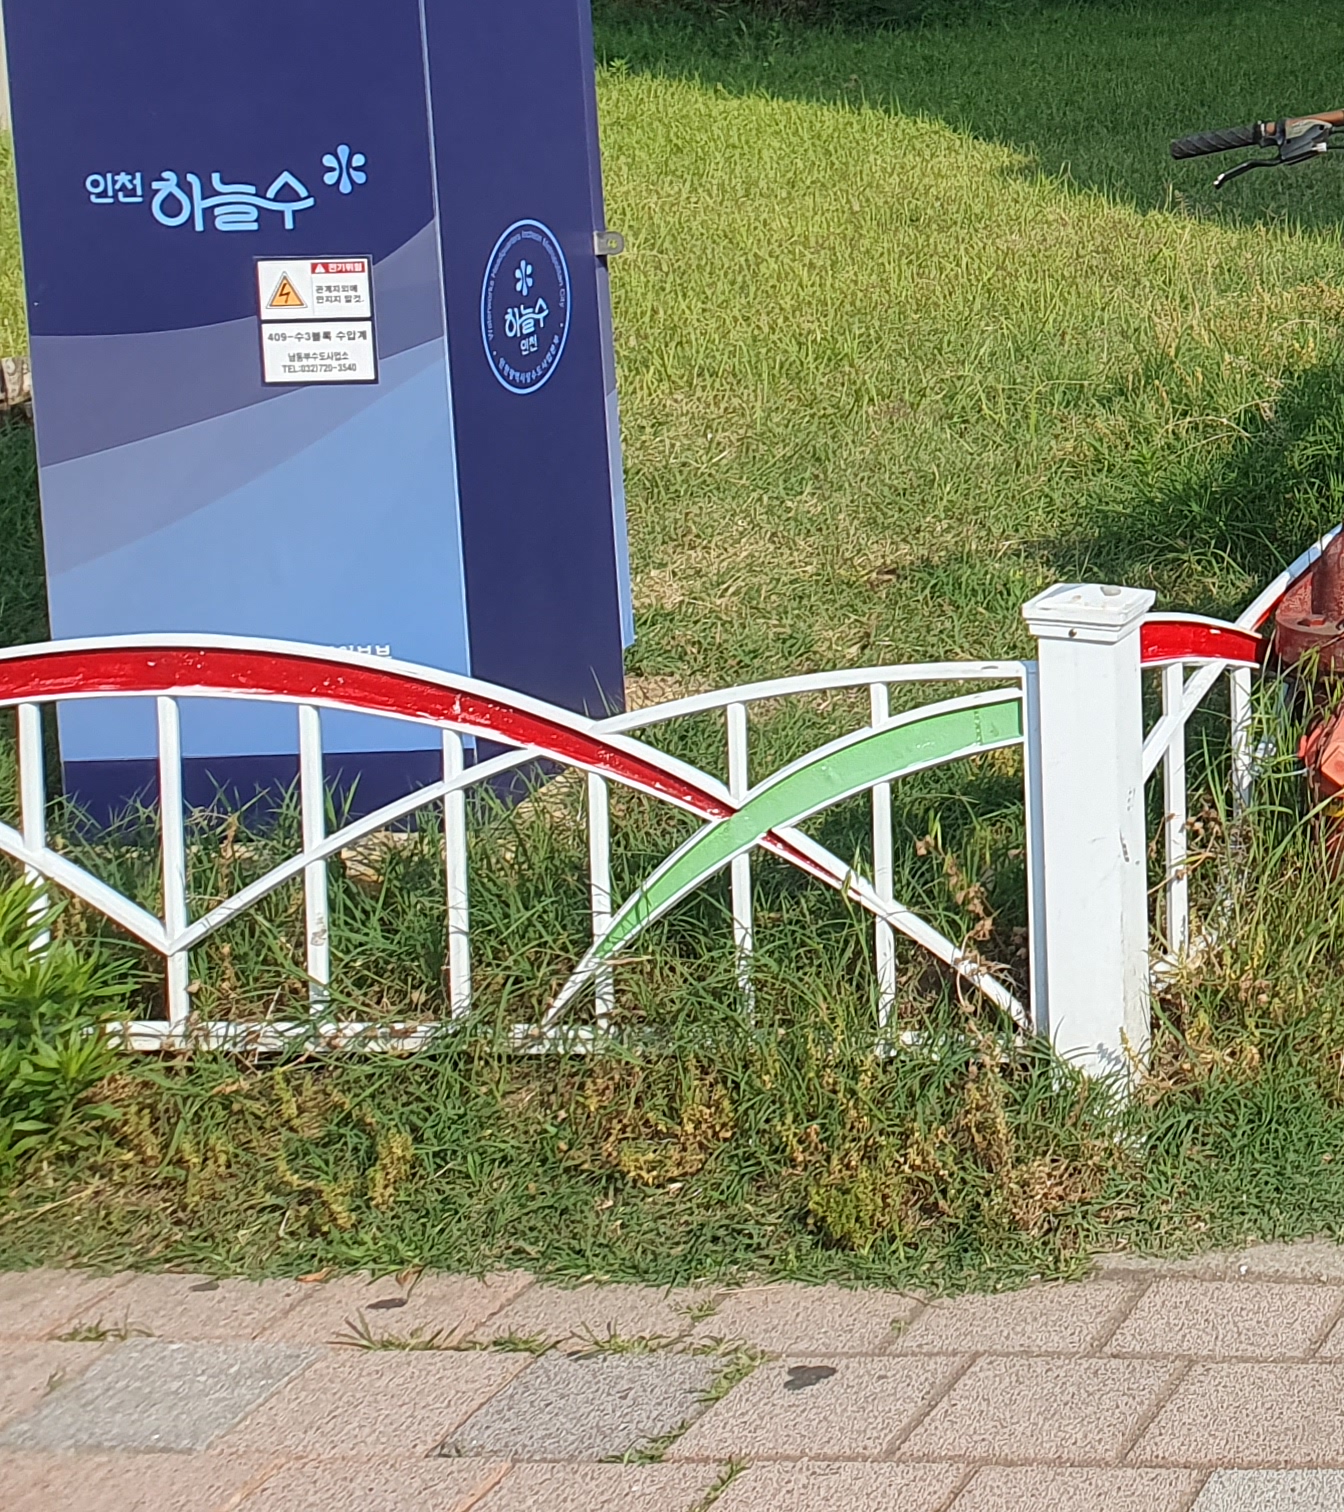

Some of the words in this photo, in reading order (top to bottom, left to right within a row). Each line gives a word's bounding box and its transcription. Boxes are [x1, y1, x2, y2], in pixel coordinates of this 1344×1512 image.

[85, 172, 144, 203] 인천
[151, 170, 315, 232] 하늘수
[504, 297, 549, 337] 하늘수
[520, 334, 539, 356] 인천
